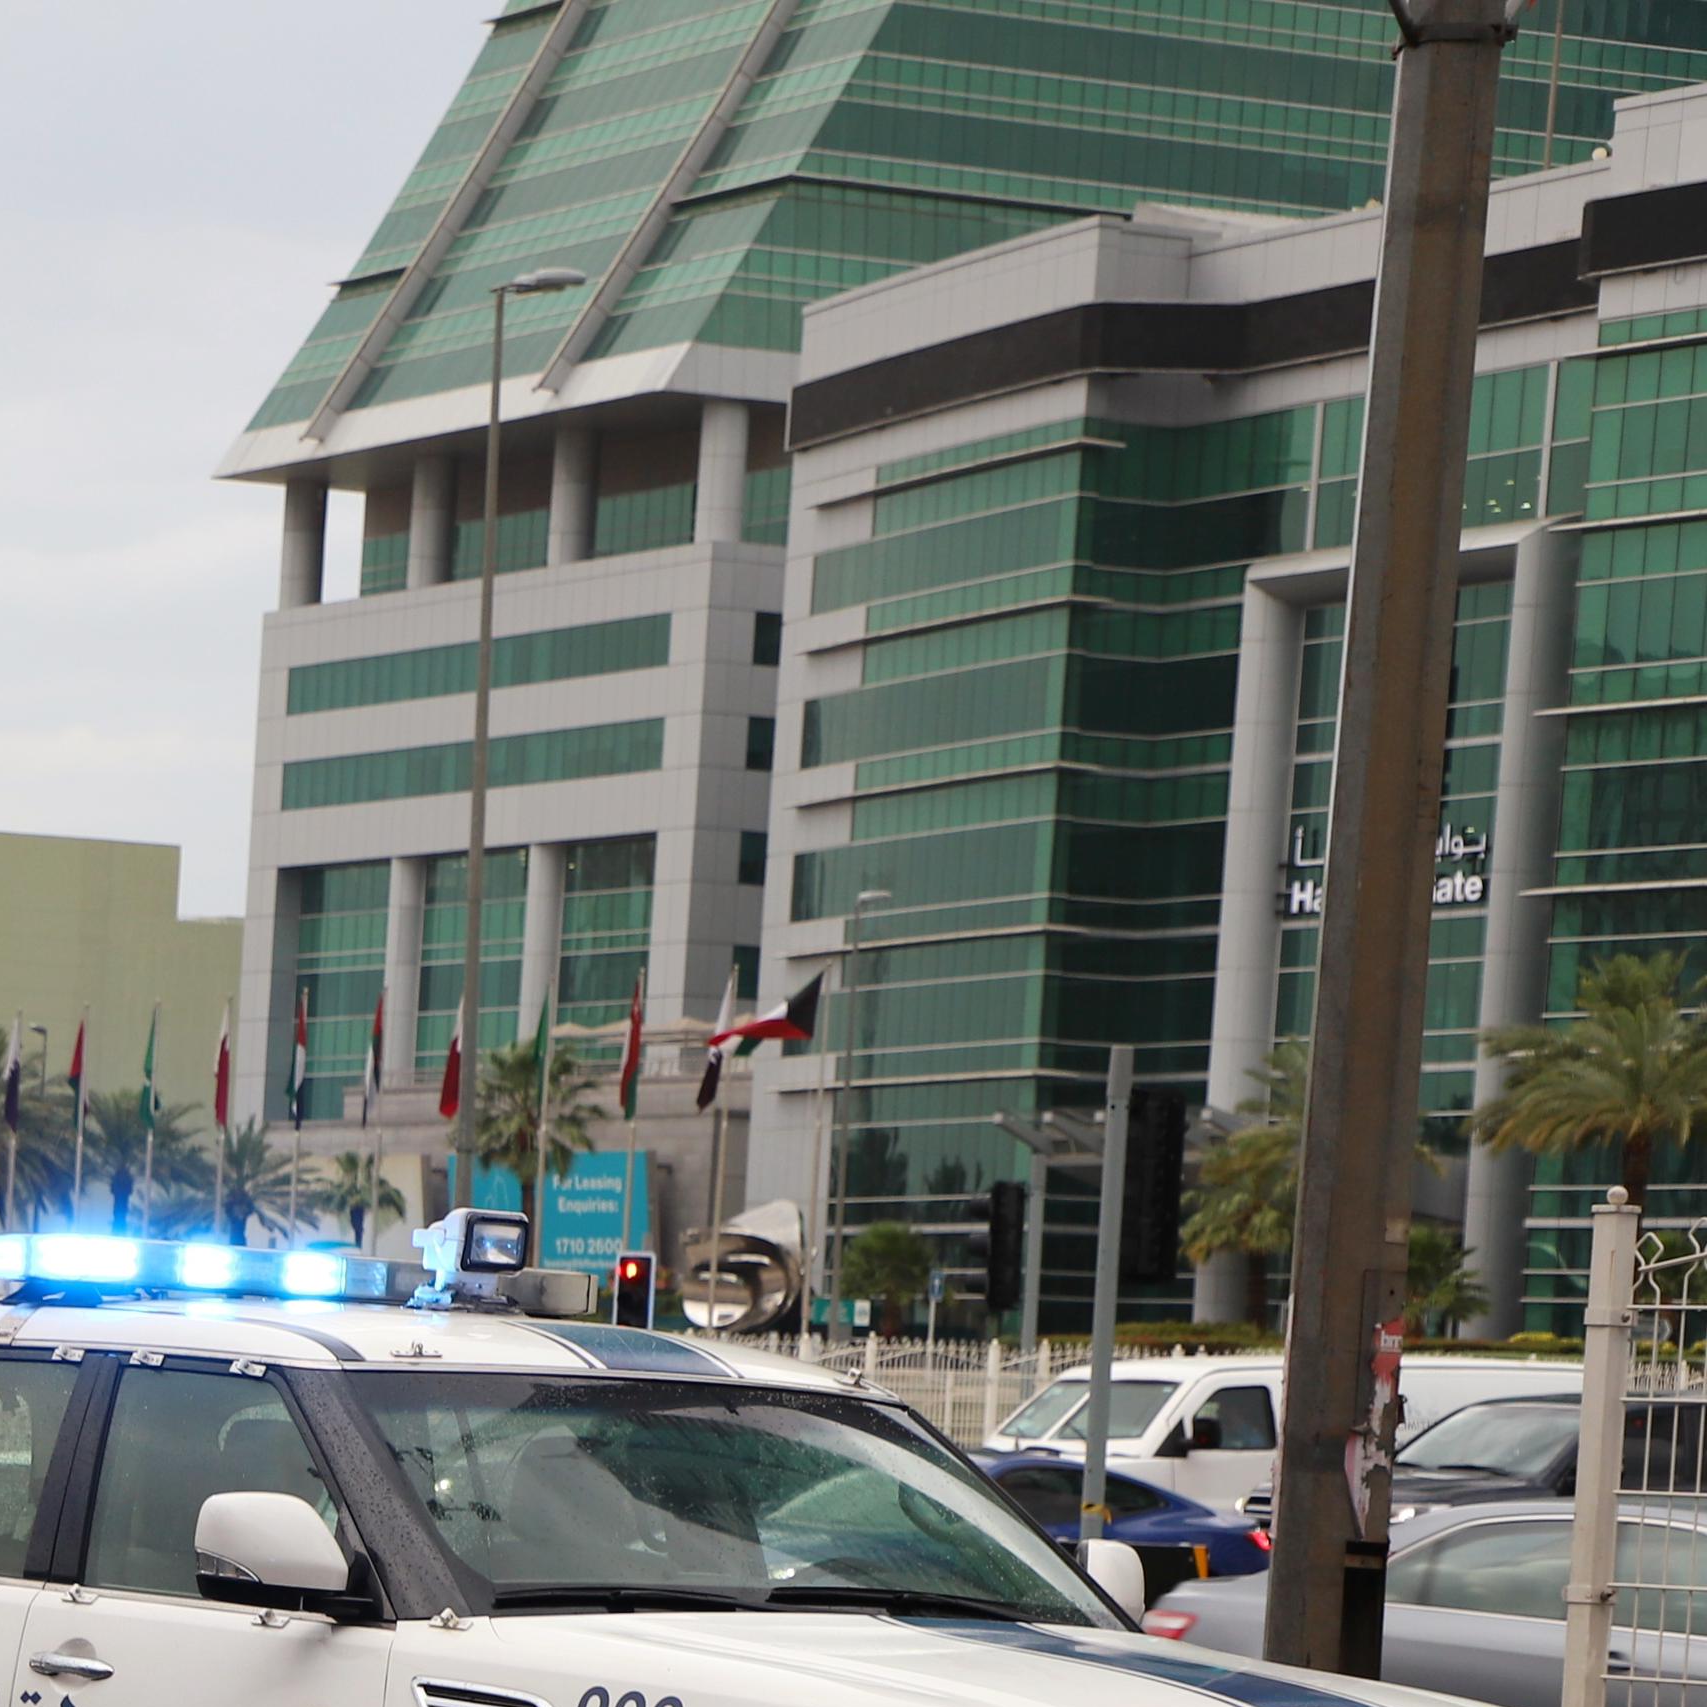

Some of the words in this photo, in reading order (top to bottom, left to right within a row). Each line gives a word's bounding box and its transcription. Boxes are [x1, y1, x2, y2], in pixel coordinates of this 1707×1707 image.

[1433, 869, 1484, 904] ate
[575, 1174, 622, 1194] Leasing
[557, 1196, 619, 1216] Enquiries:
